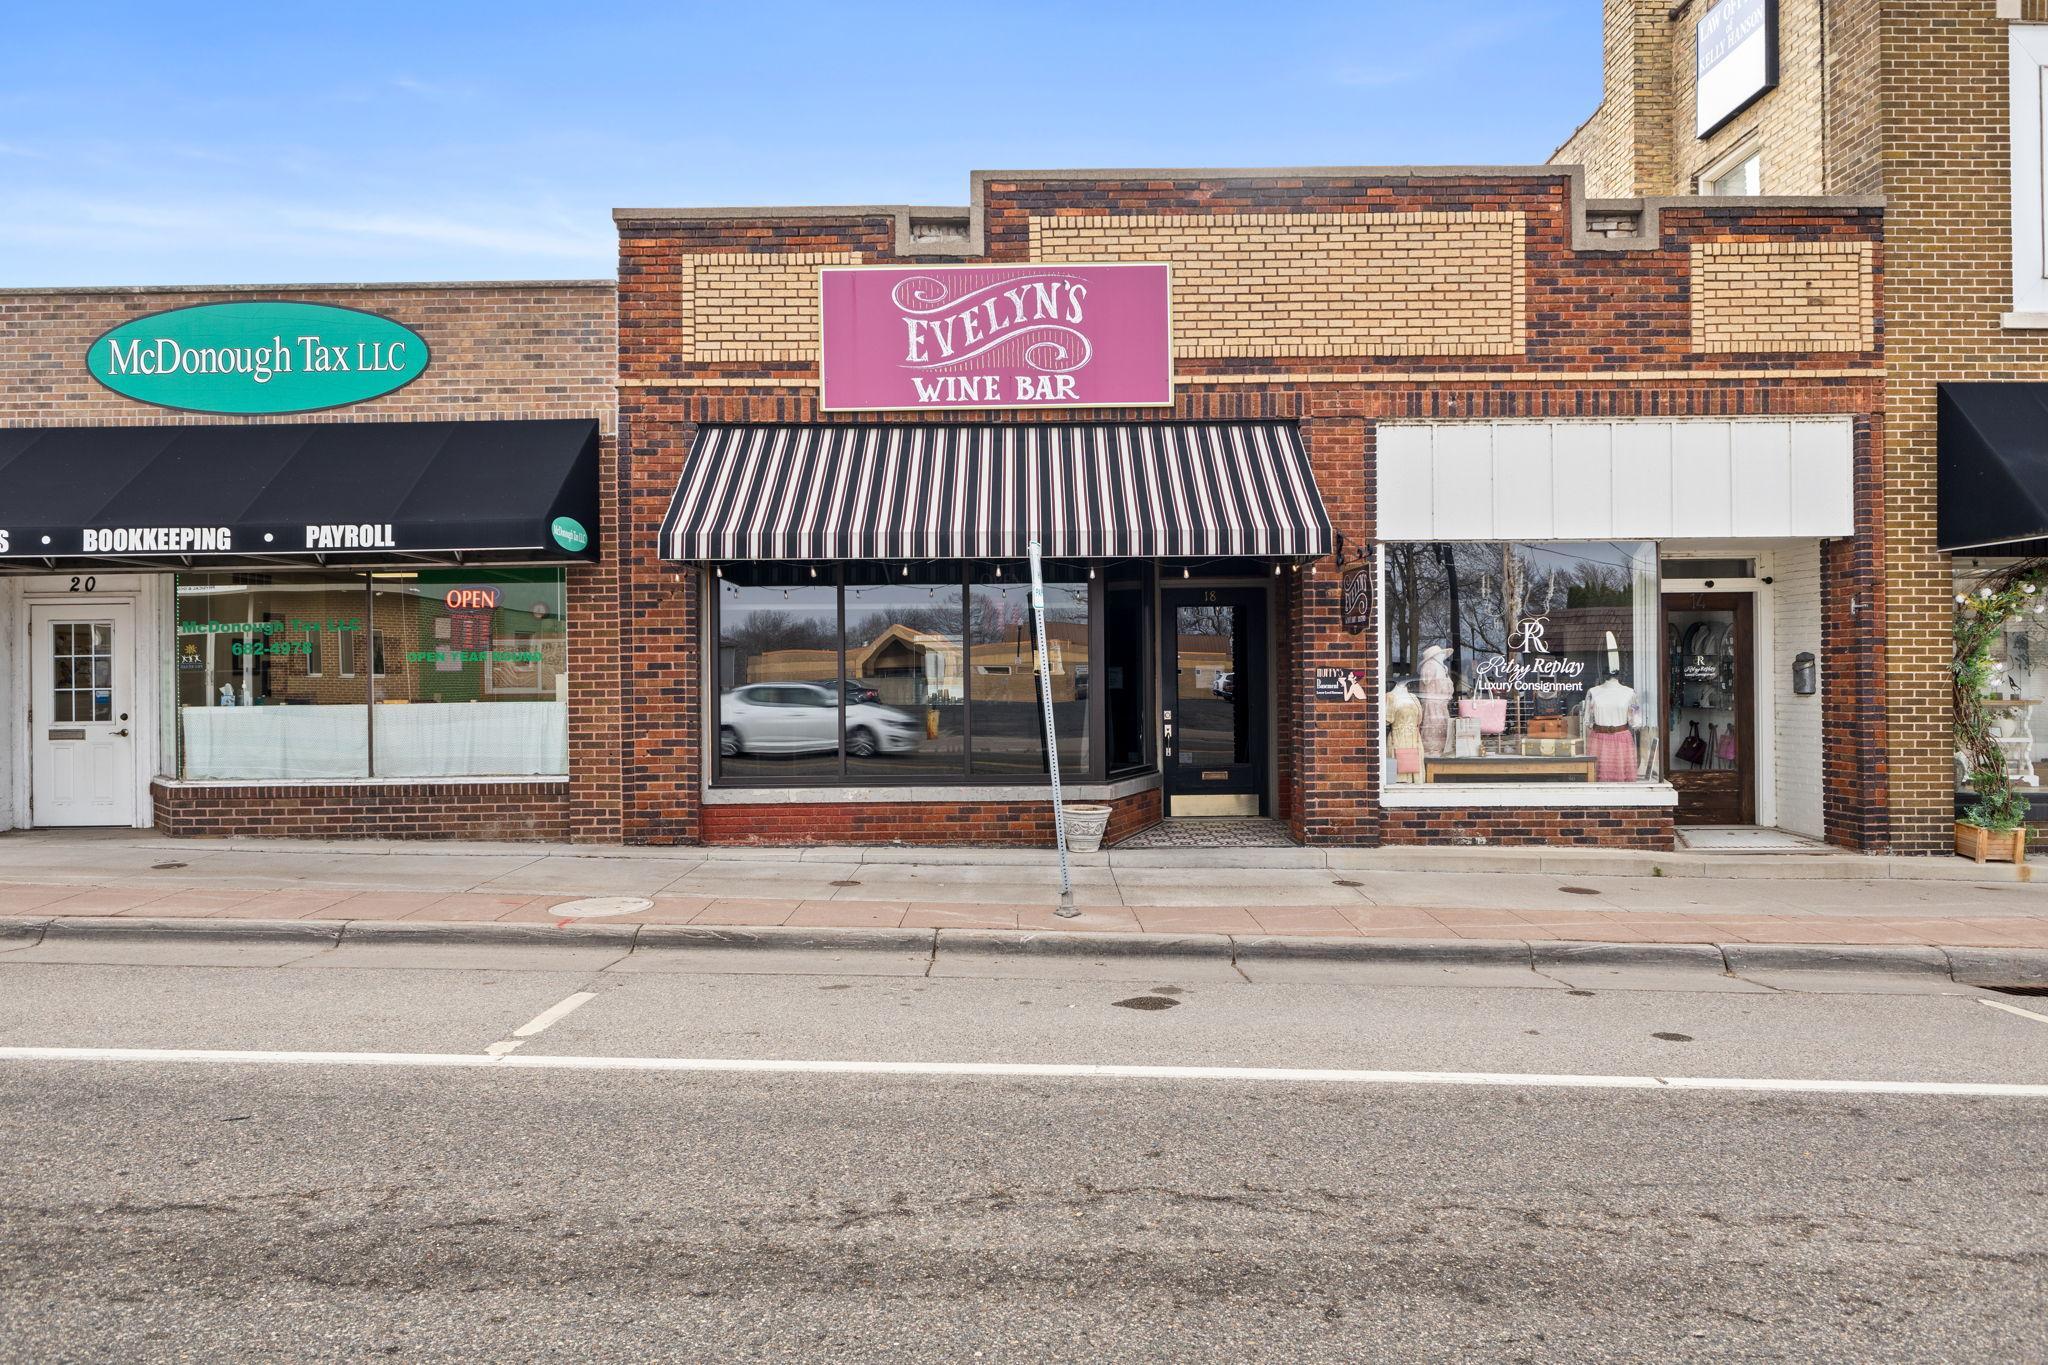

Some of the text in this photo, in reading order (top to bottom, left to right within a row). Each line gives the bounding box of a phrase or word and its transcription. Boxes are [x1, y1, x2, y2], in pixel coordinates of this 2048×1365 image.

[902, 280, 1087, 363] EVELYN'S
[108, 335, 406, 383] McDonough Tax LLC
[911, 374, 1080, 402] WINE BAR
[83, 527, 231, 551] BOOKKEEPING
[306, 524, 395, 548] PAYROLL
[70, 576, 96, 592] 20
[446, 589, 495, 608] OPEN
[1205, 590, 1217, 602] 18
[182, 617, 363, 635] McDonough Tax LLC
[232, 641, 313, 656] 682-4978
[406, 651, 542, 662] OPEN YEAR ROUND
[1476, 655, 1584, 683] Ritzy Replay
[1478, 681, 1583, 693] Luxury Consignment
